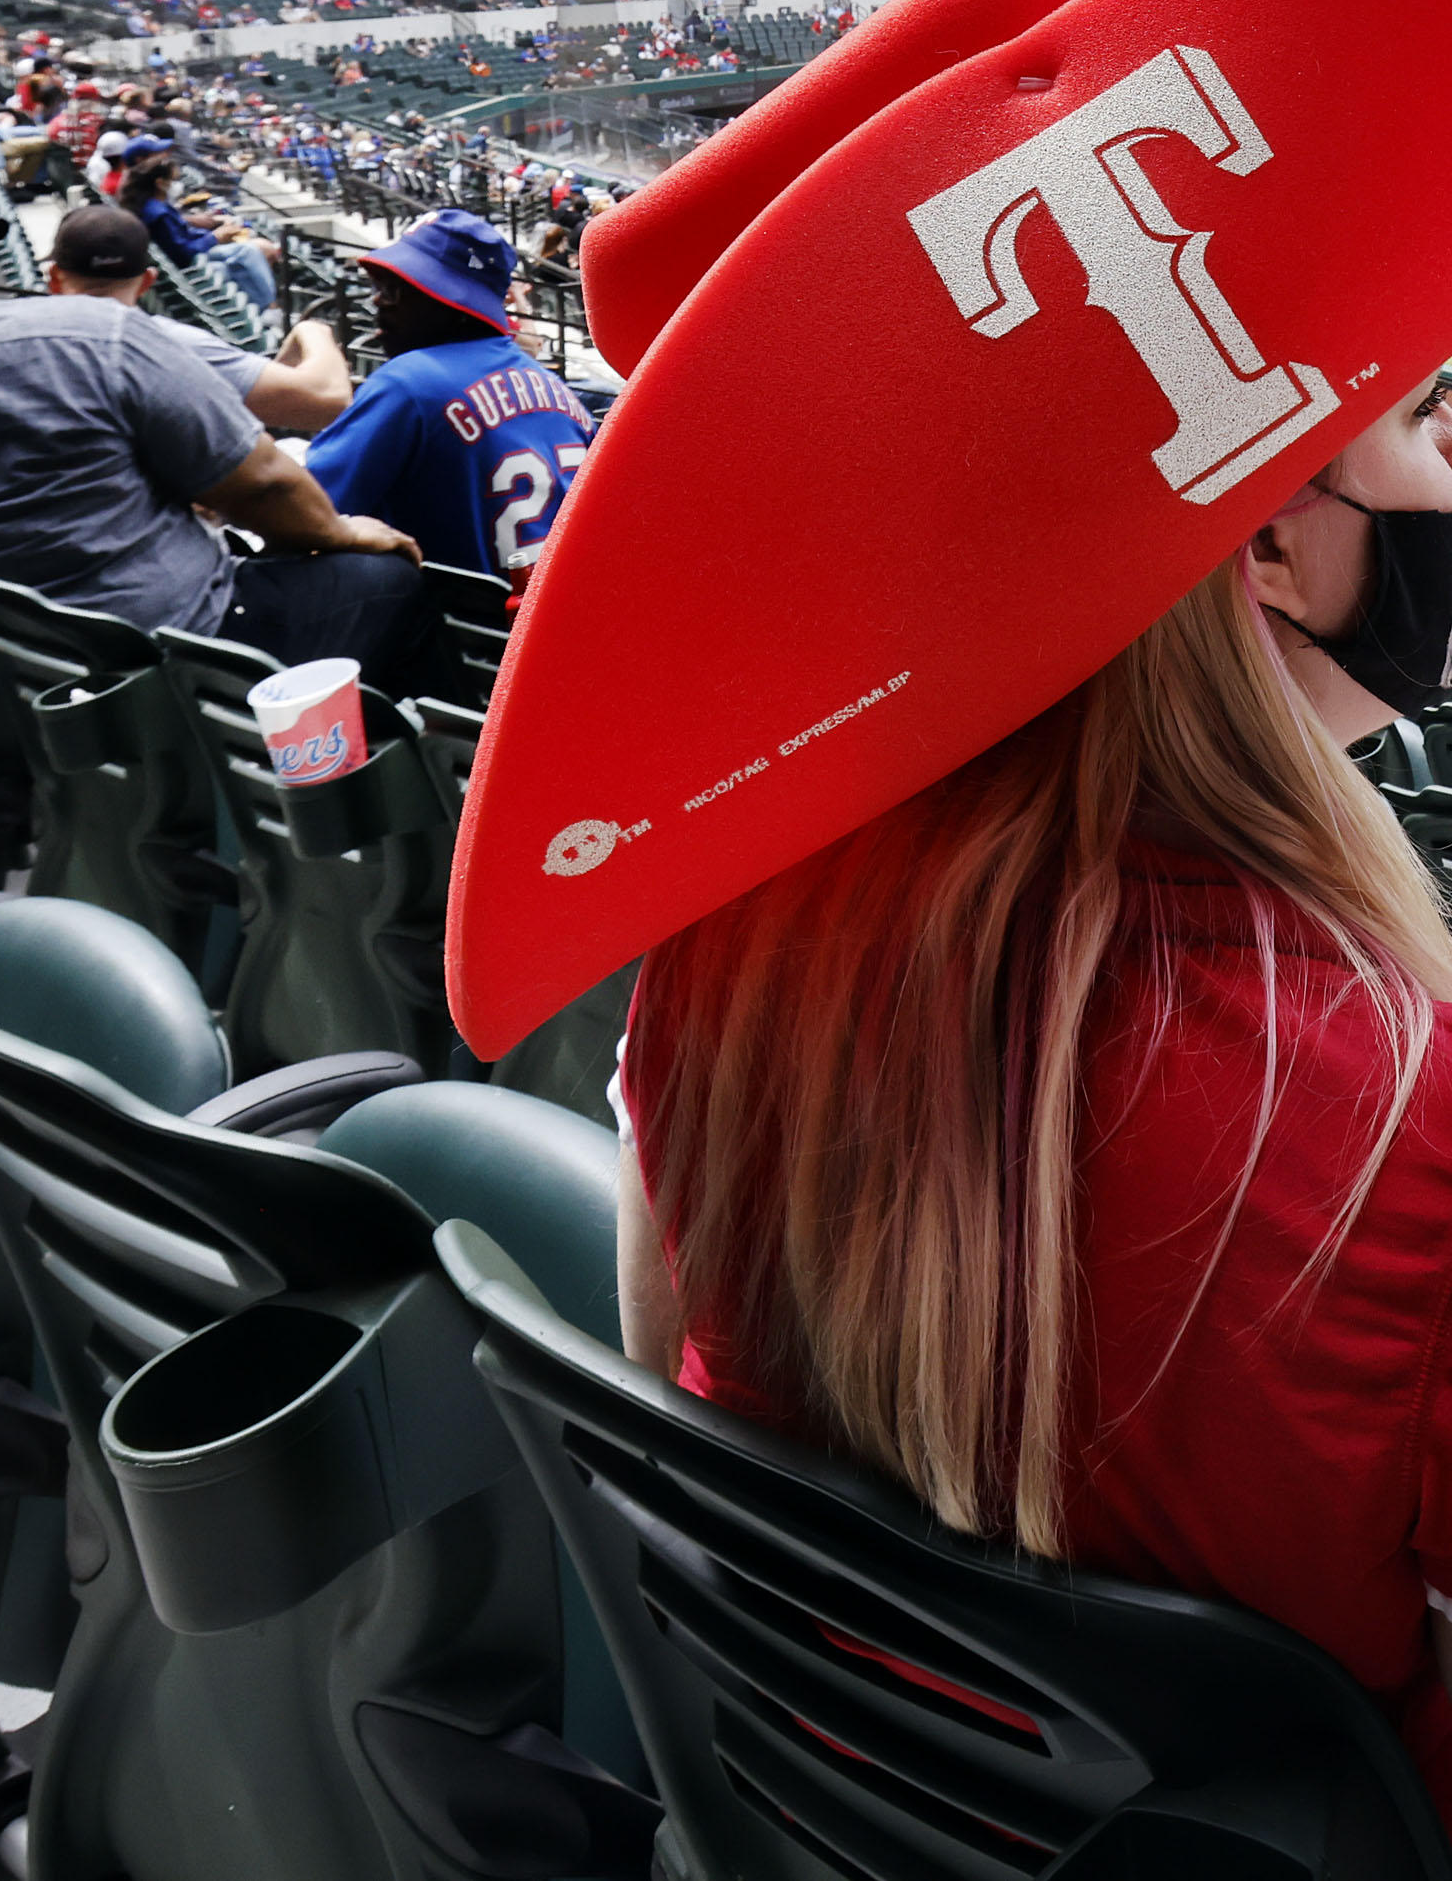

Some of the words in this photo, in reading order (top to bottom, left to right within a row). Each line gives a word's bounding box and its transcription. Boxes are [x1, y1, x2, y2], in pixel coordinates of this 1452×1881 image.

[905, 44, 1342, 506] T
[490, 443, 590, 571] 2
[684, 757, 770, 813] RICO/TAG
[778, 671, 912, 757] EXPRESS/MLBP
